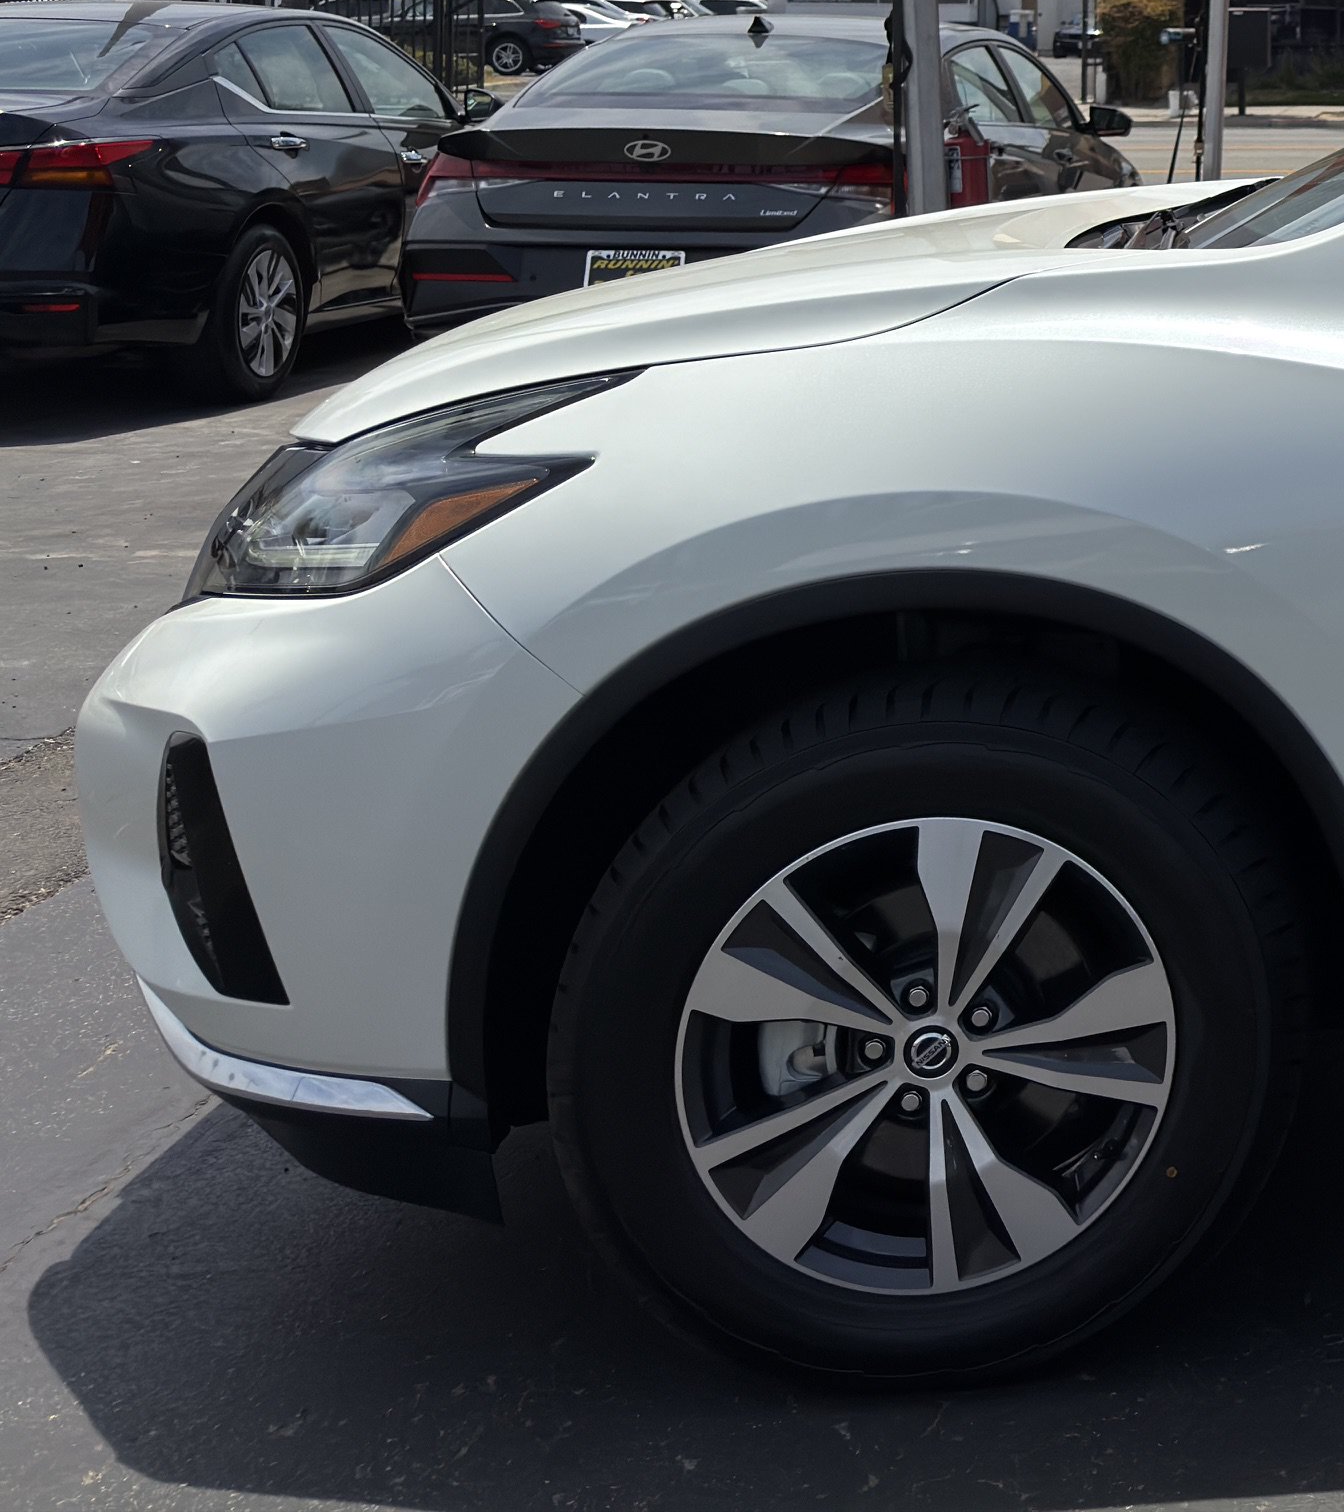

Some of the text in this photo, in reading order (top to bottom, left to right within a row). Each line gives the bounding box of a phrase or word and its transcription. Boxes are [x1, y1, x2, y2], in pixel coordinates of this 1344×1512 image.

[552, 190, 736, 201] ELANTRA
[760, 208, 798, 216] Limited
[612, 250, 660, 260] BUNNIN
